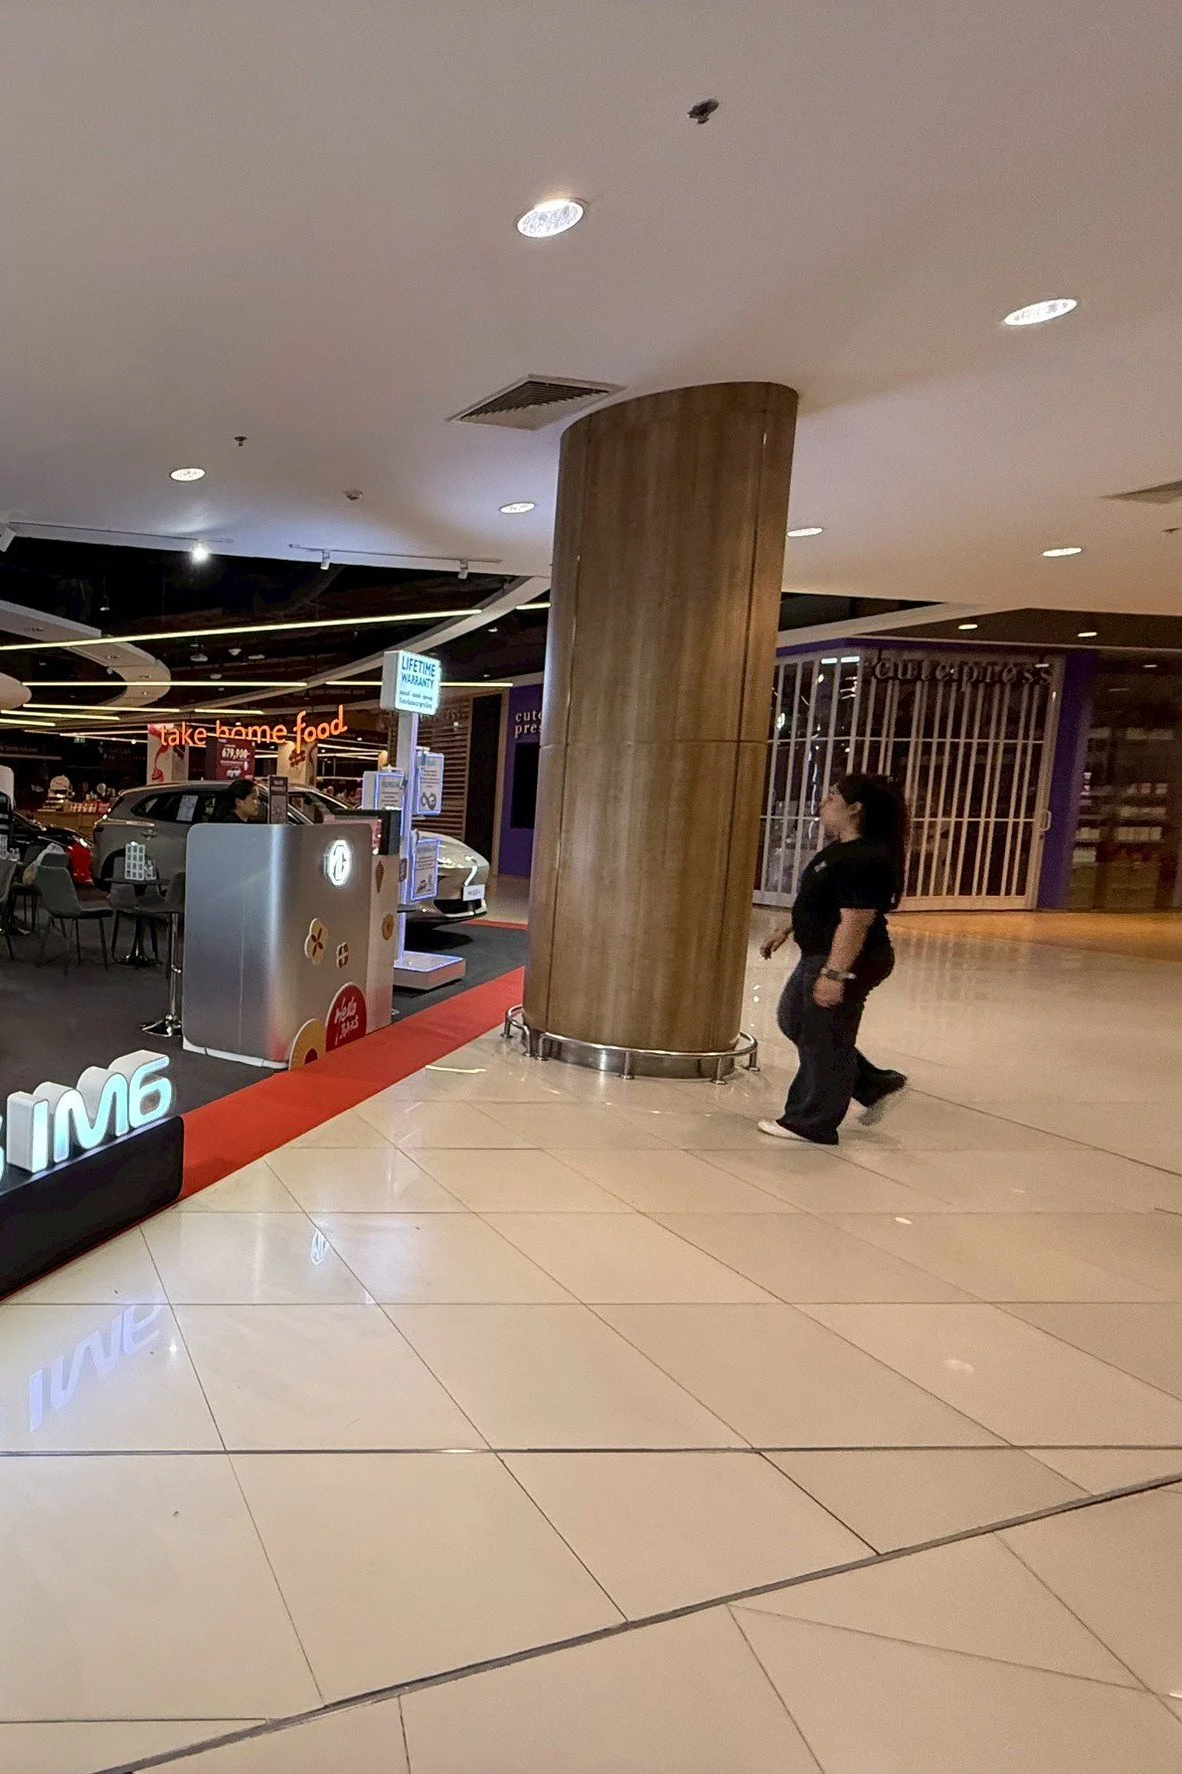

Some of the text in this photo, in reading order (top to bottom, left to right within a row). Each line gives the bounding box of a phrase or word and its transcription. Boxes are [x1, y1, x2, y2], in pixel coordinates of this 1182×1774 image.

[401, 656, 436, 677] LIFETIME
[401, 672, 435, 689] WARRANTY
[159, 704, 348, 754] take home food
[7, 1050, 174, 1173] IM6
